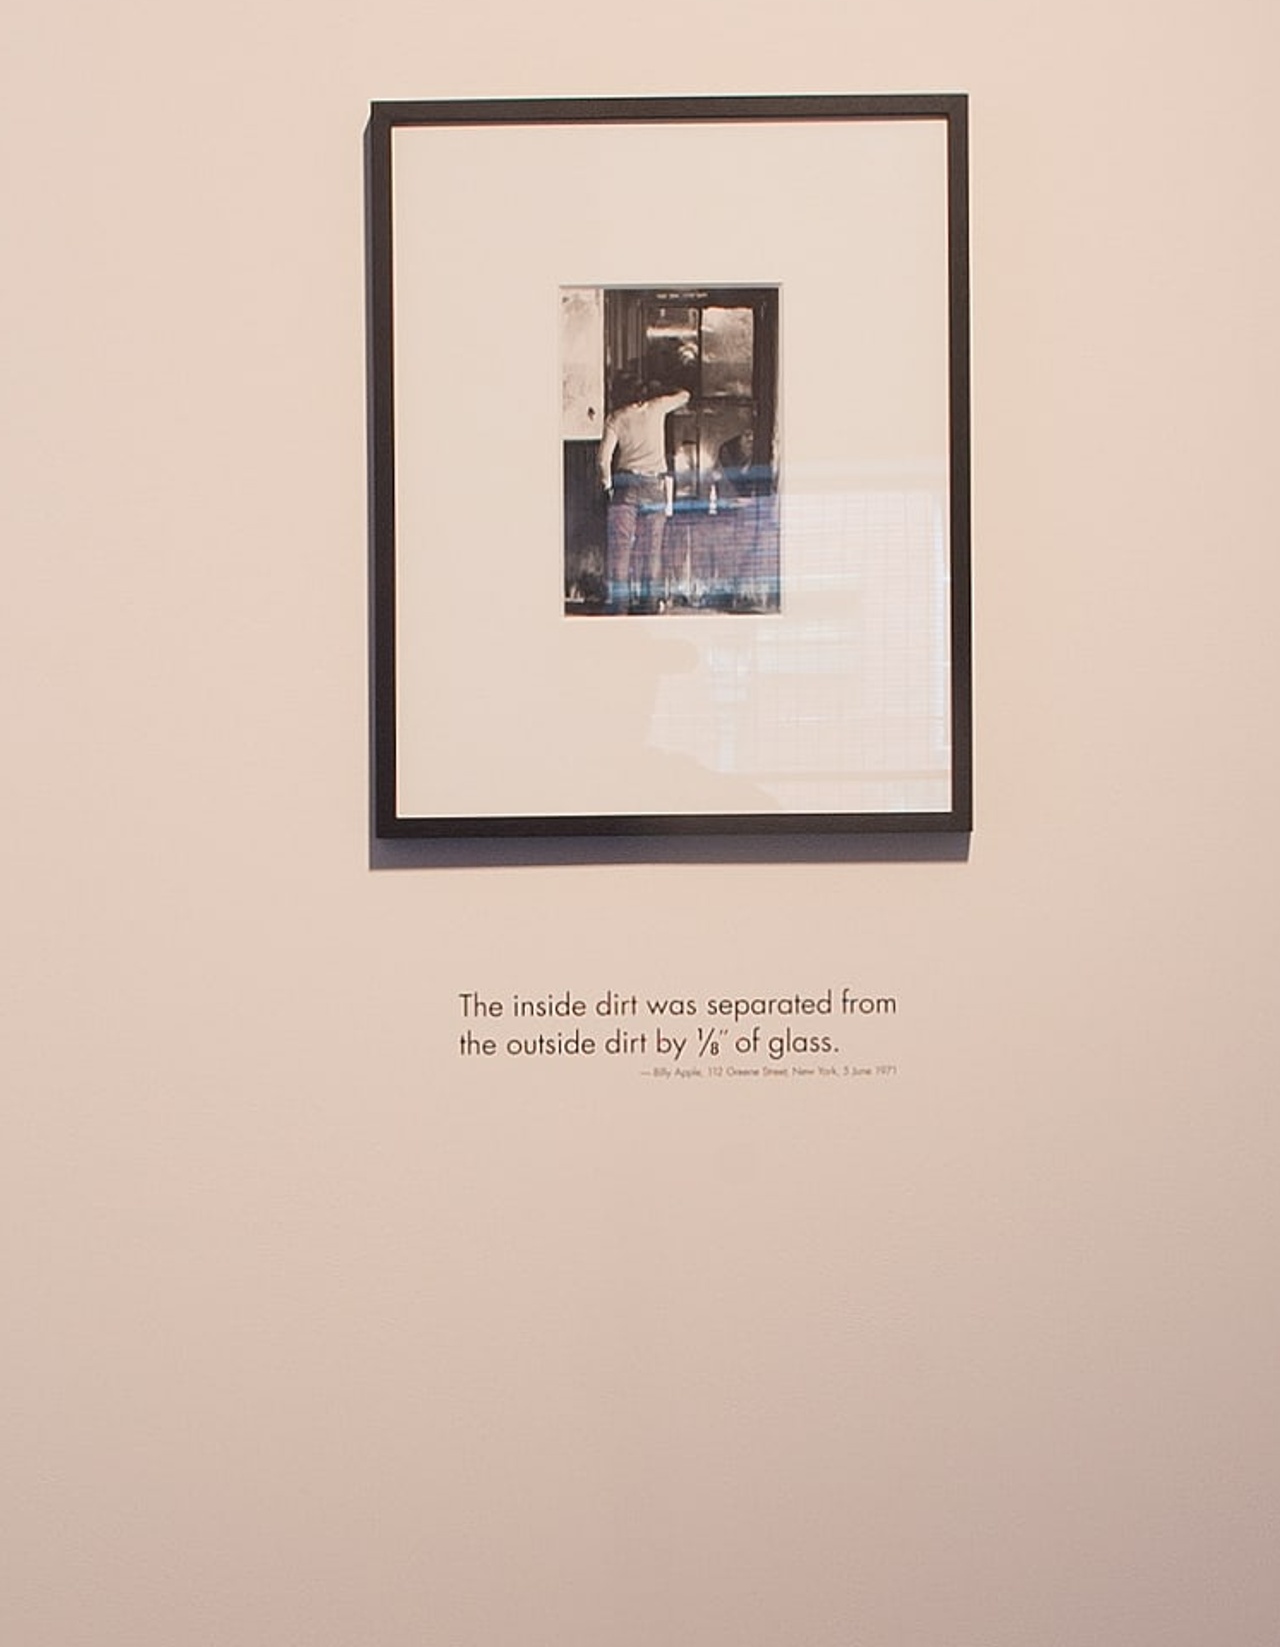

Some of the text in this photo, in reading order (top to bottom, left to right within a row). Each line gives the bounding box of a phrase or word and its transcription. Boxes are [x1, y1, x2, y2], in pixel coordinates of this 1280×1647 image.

[459, 988, 897, 1023] The inside dirt was separated from
[459, 1030, 497, 1056] the
[507, 1029, 596, 1056] outside
[605, 1028, 647, 1055] dirt
[656, 1028, 687, 1061] by
[735, 1026, 761, 1054] of
[768, 1026, 839, 1061] glass.
